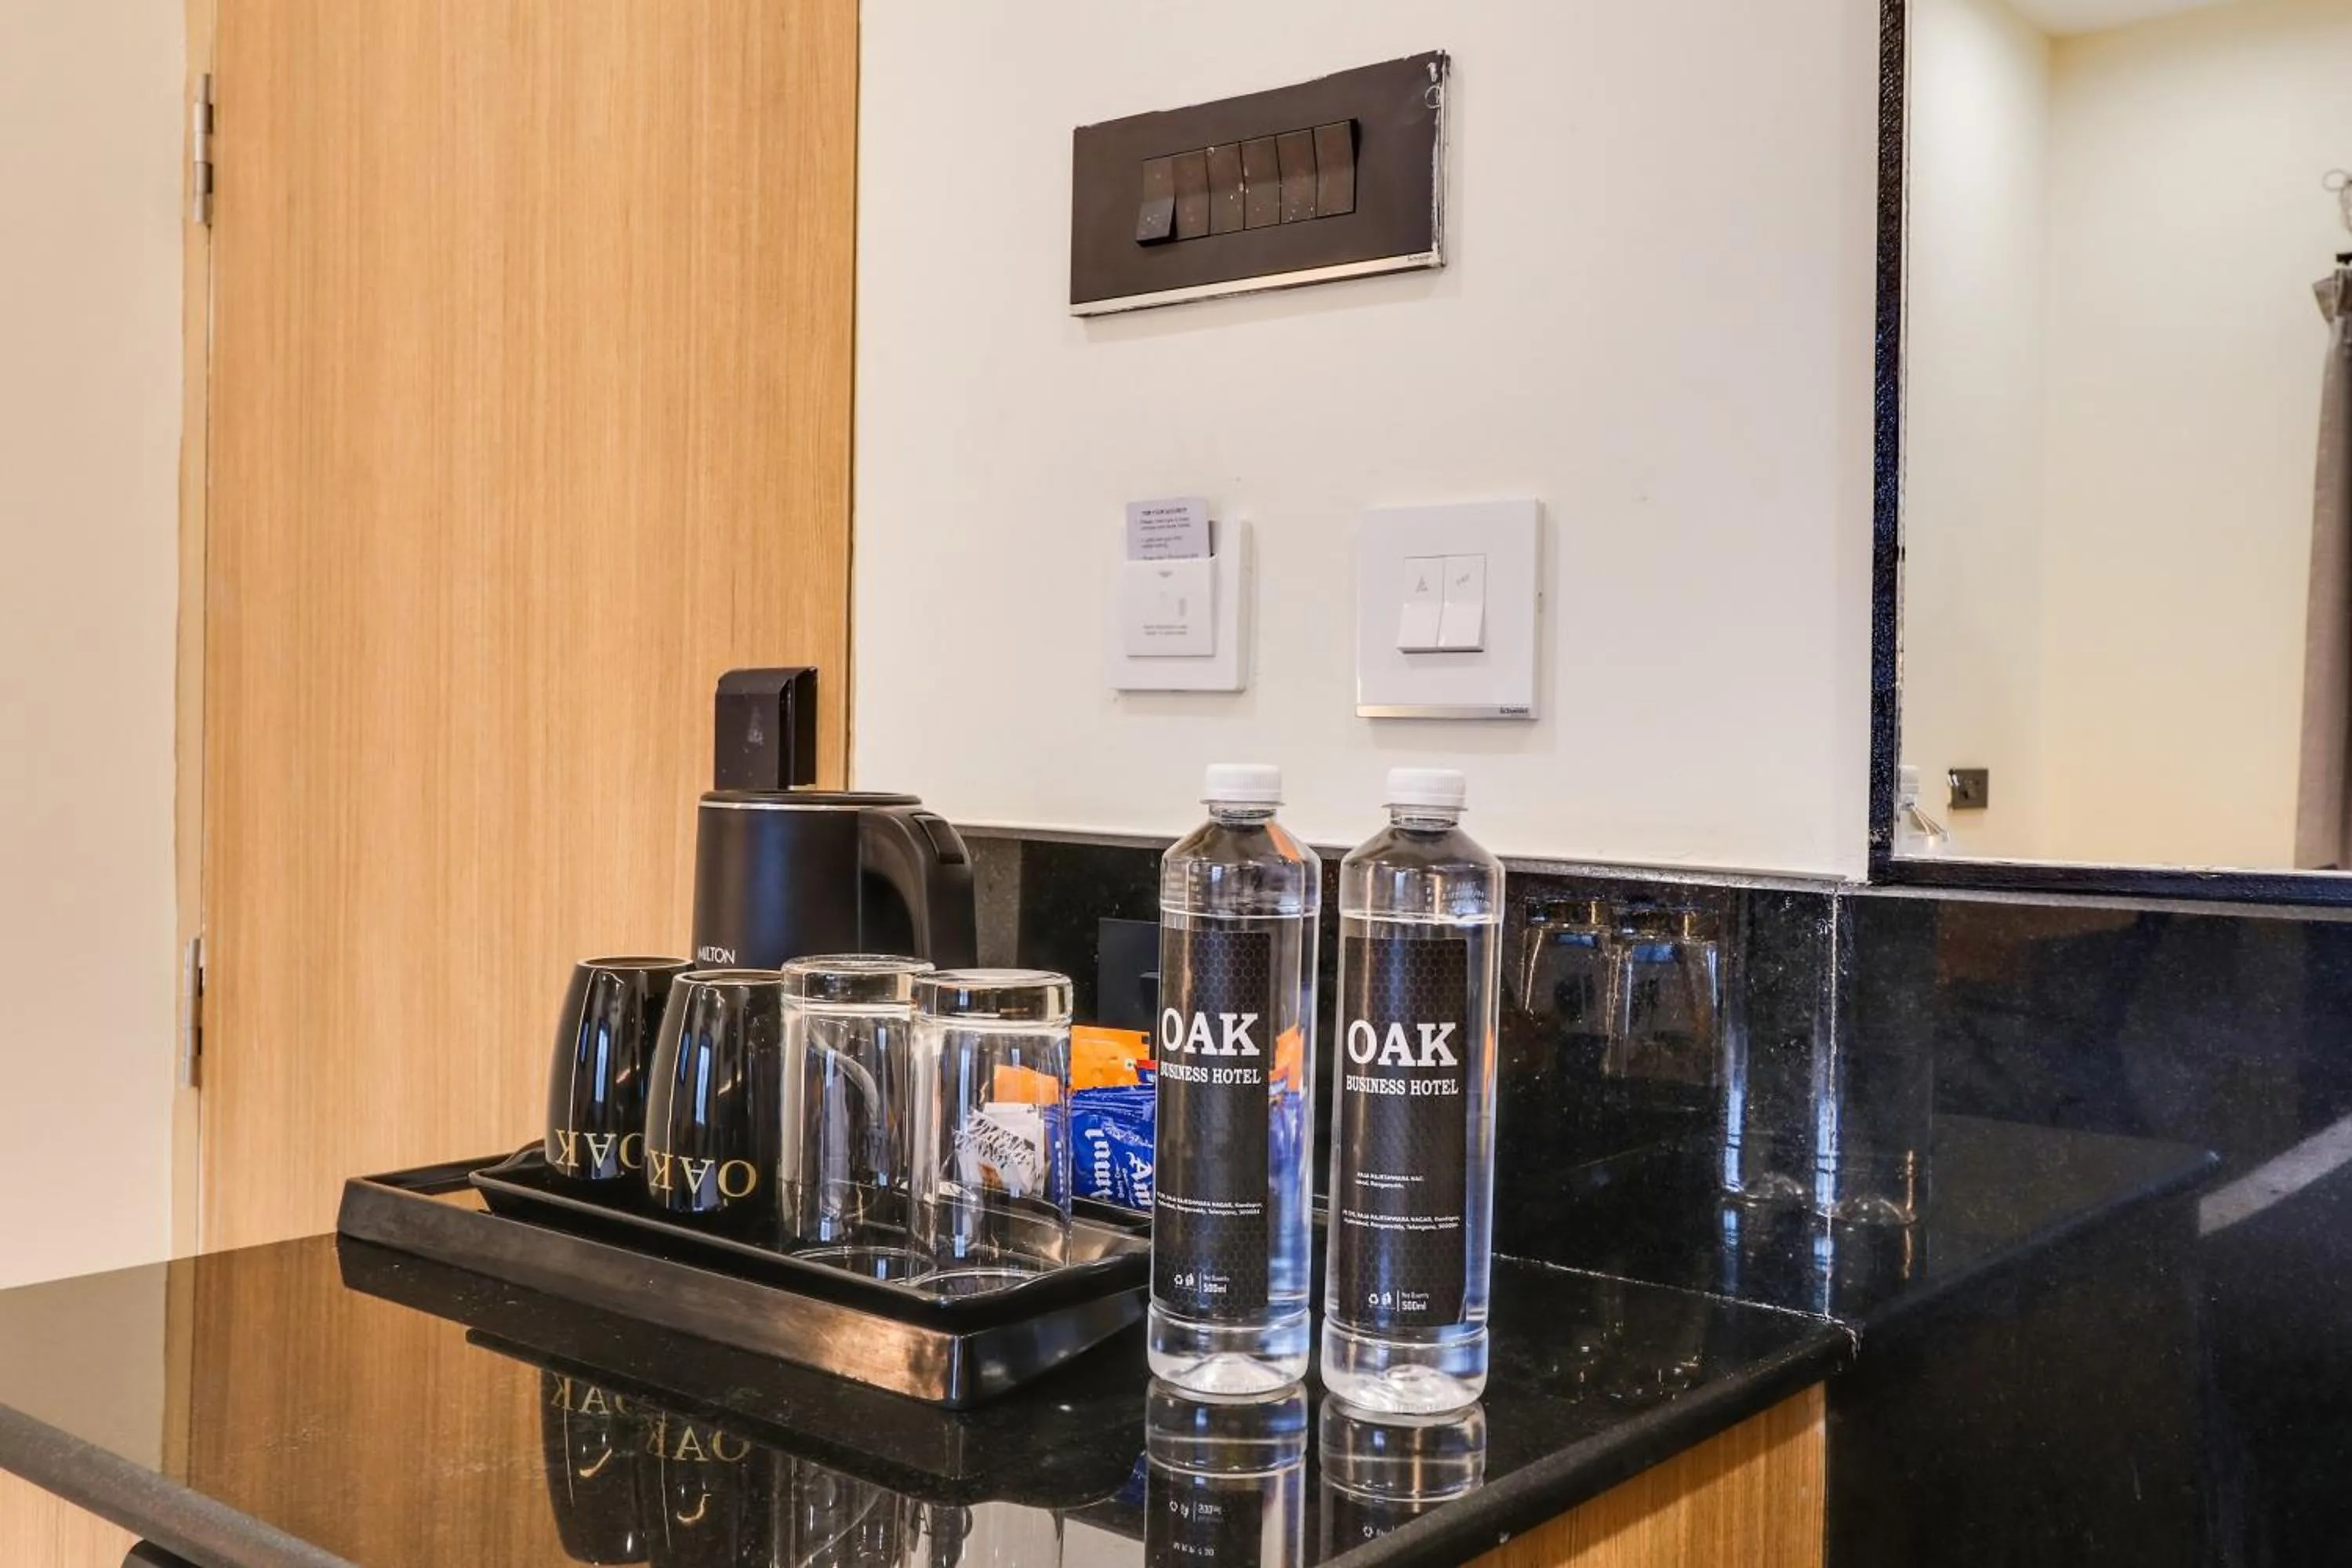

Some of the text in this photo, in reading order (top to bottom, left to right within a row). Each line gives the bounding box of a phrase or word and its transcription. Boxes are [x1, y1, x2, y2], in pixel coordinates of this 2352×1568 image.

[698, 946, 736, 964] MILTON
[1161, 1007, 1260, 1056] OAK
[1348, 1020, 1458, 1067] OAK
[1160, 1061, 1208, 1083] BUSINESS
[1212, 1068, 1261, 1084] HOTEL
[1346, 1075, 1459, 1095] BUSINESS HOTEL
[649, 1149, 757, 1197] OAK
[1401, 1301, 1427, 1311] 500ml
